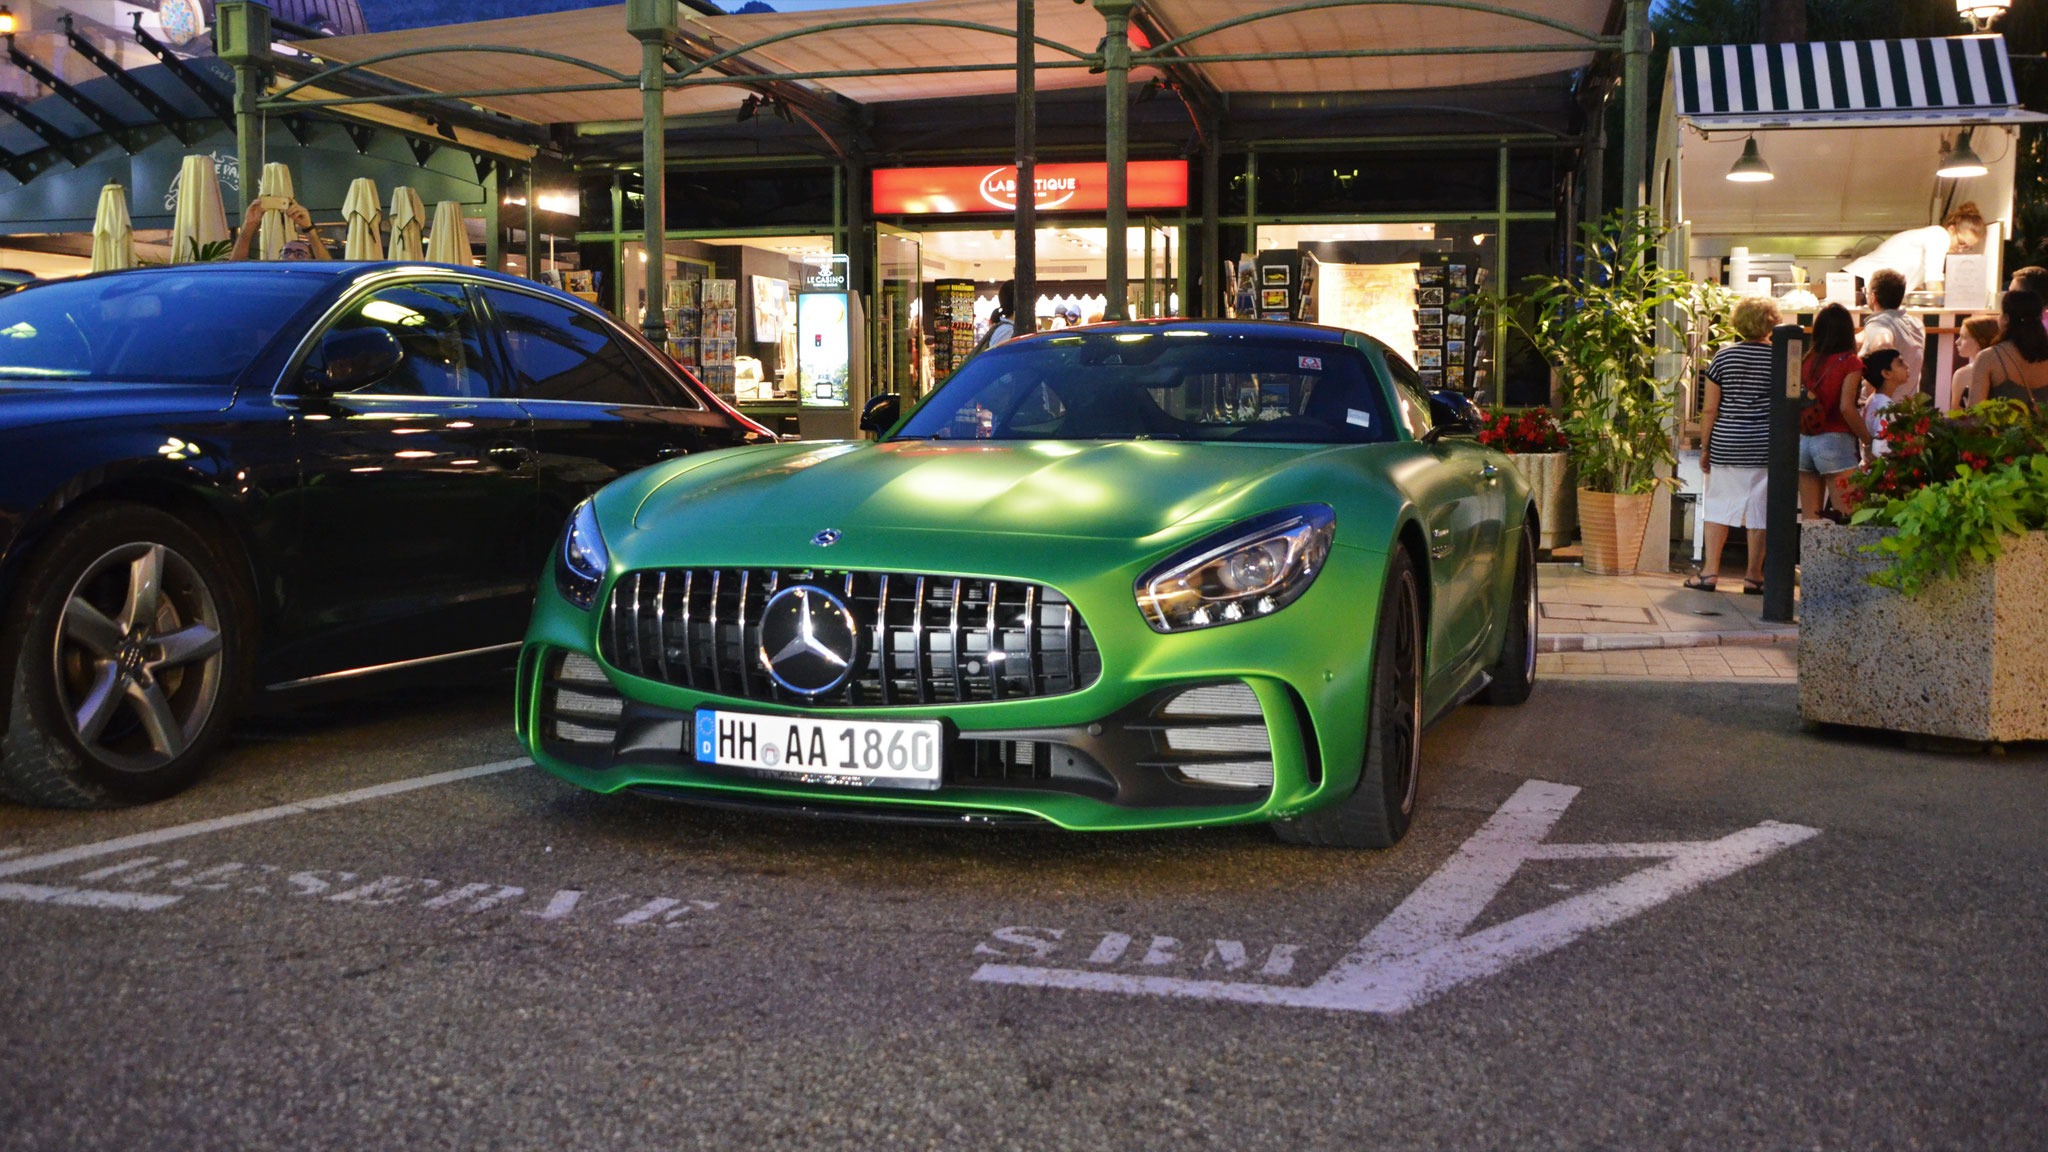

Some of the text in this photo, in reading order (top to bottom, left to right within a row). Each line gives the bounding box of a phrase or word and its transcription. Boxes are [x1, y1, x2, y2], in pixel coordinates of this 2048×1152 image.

[988, 178, 1076, 192] LABTIQUE
[815, 276, 845, 284] CASINO
[703, 741, 710, 754] D
[719, 718, 933, 772] HH AA 1860
